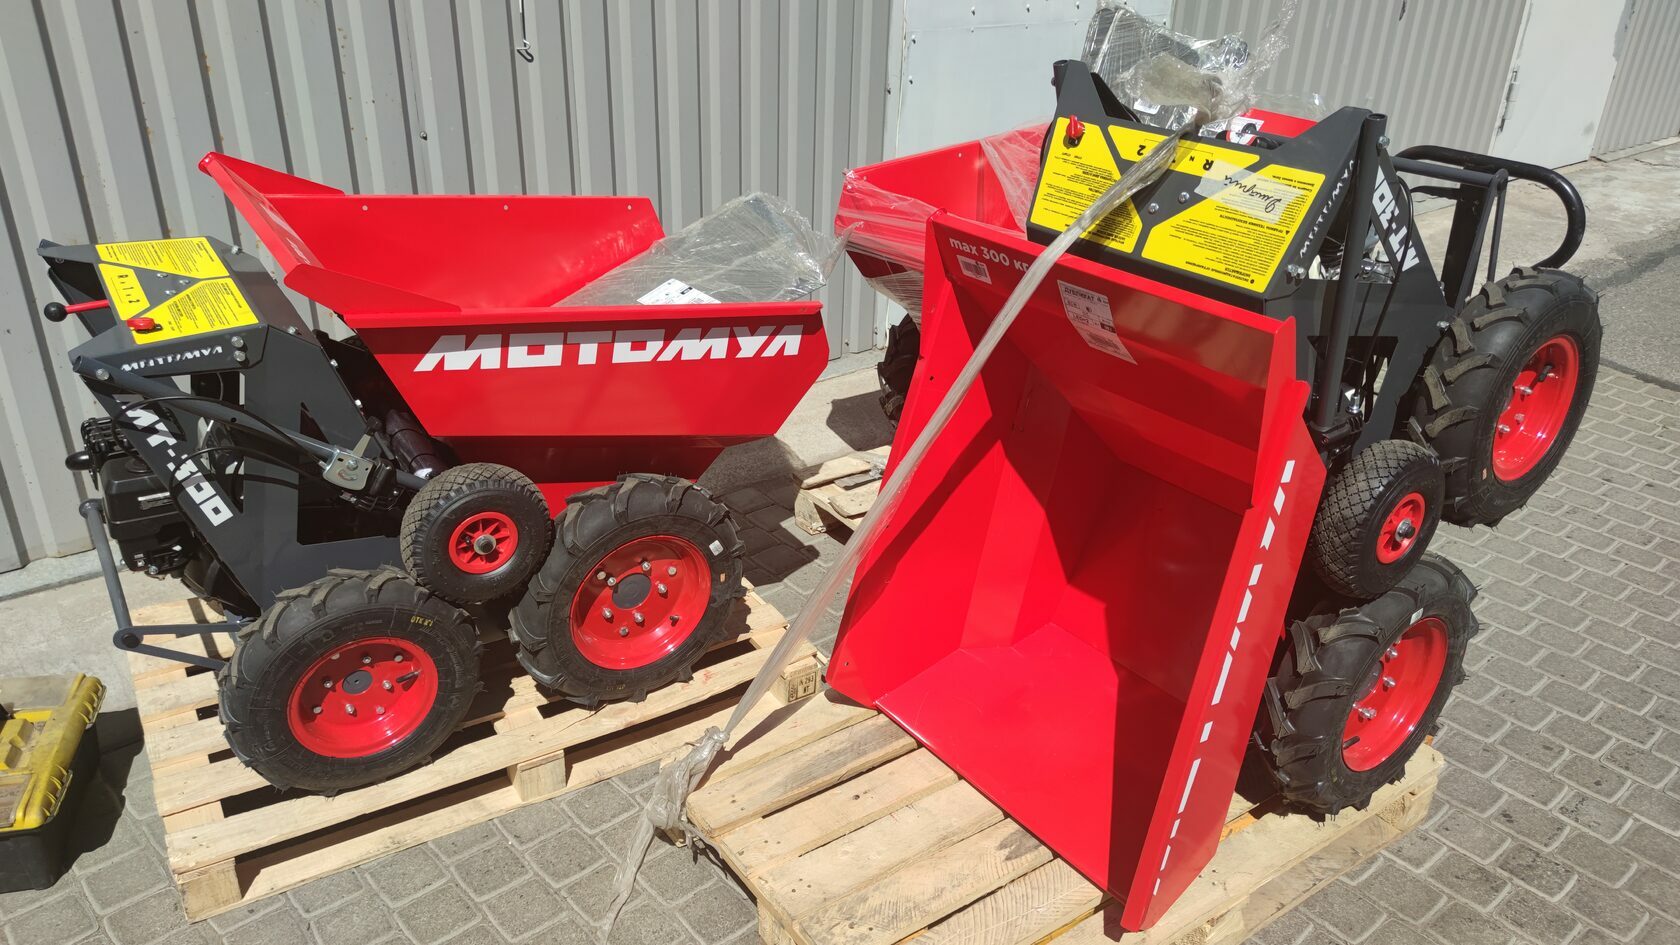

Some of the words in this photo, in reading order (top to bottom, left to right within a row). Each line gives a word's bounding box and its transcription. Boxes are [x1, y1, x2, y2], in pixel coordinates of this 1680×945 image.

[1137, 144, 1147, 156] 2
[949, 237, 979, 257] max
[981, 245, 1010, 267] 300
